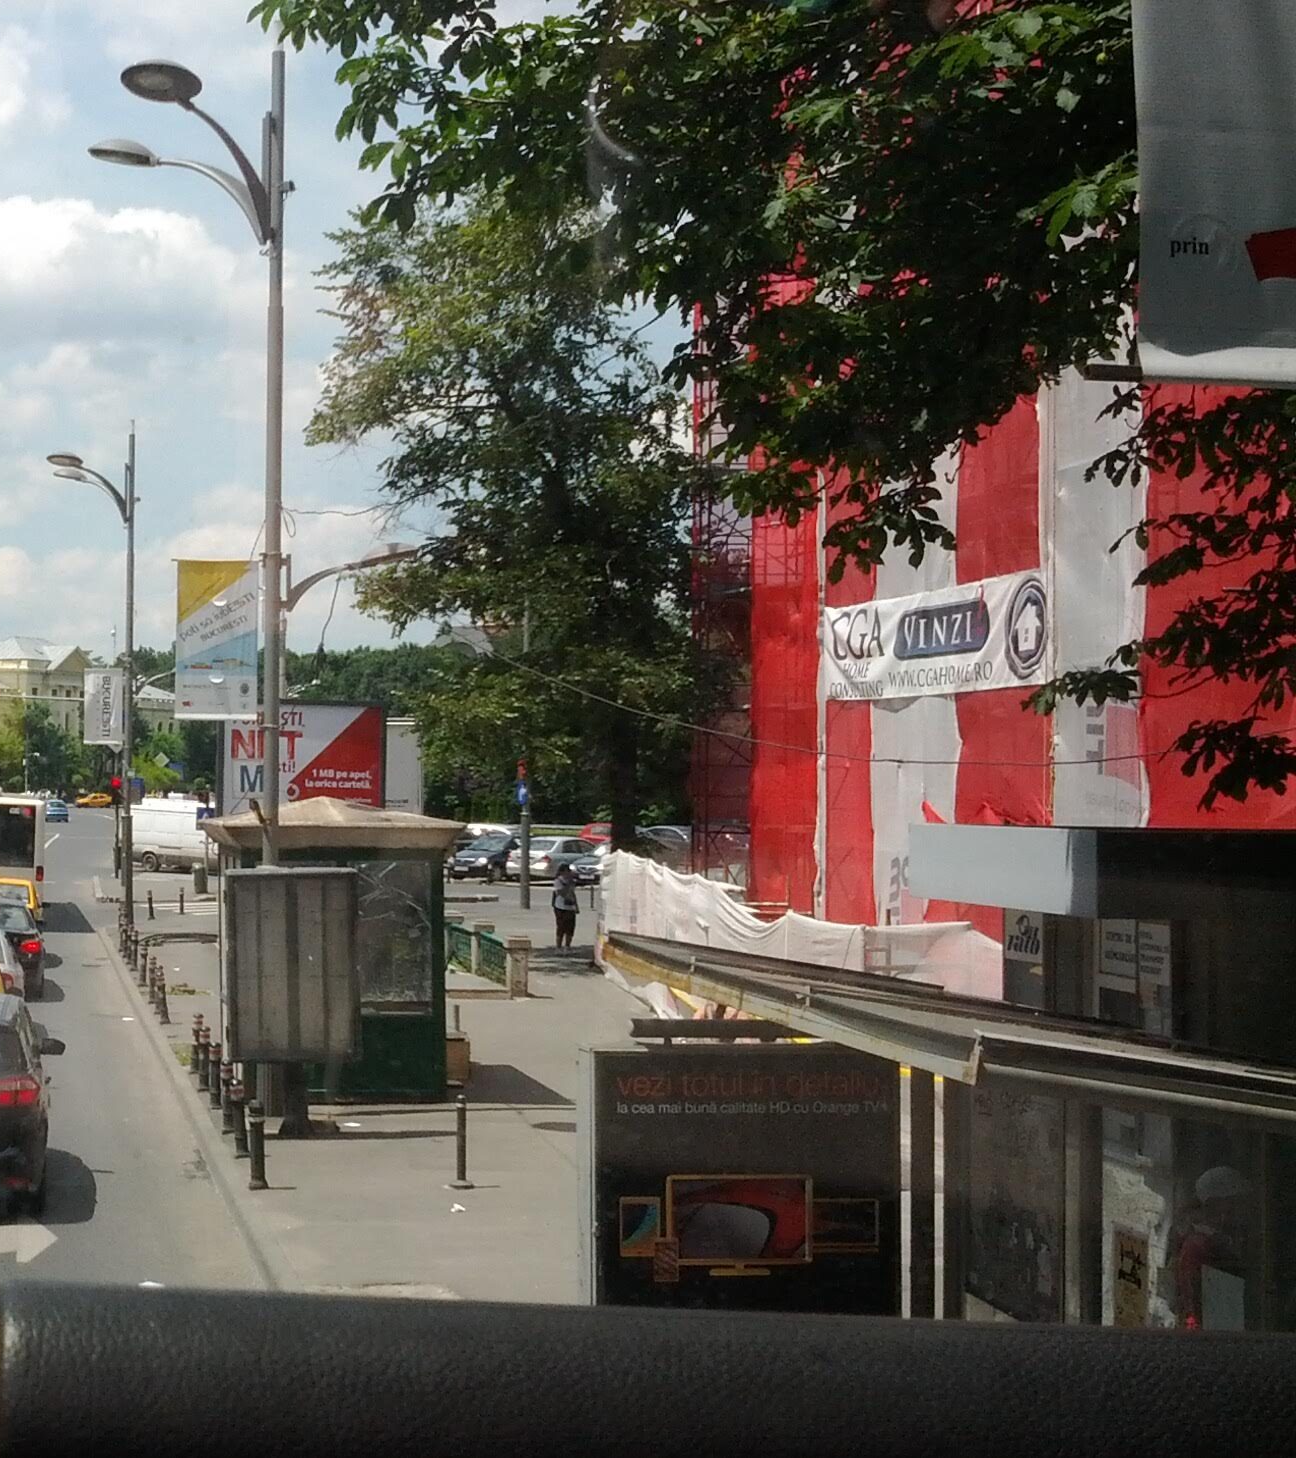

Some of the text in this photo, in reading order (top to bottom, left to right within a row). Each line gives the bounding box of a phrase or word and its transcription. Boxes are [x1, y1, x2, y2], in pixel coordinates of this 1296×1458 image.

[1170, 237, 1209, 257] prin
[831, 607, 885, 661] CGA
[312, 769, 317, 777] 1
[336, 772, 347, 780] pe
[315, 780, 337, 788] orice
[617, 1101, 628, 1114] la
[632, 1103, 655, 1114] cea
[659, 1102, 682, 1114] mai
[720, 1101, 765, 1114] calitate
[769, 1102, 790, 1113] HD
[793, 1103, 809, 1114] cu
[812, 1101, 859, 1117] Orange
